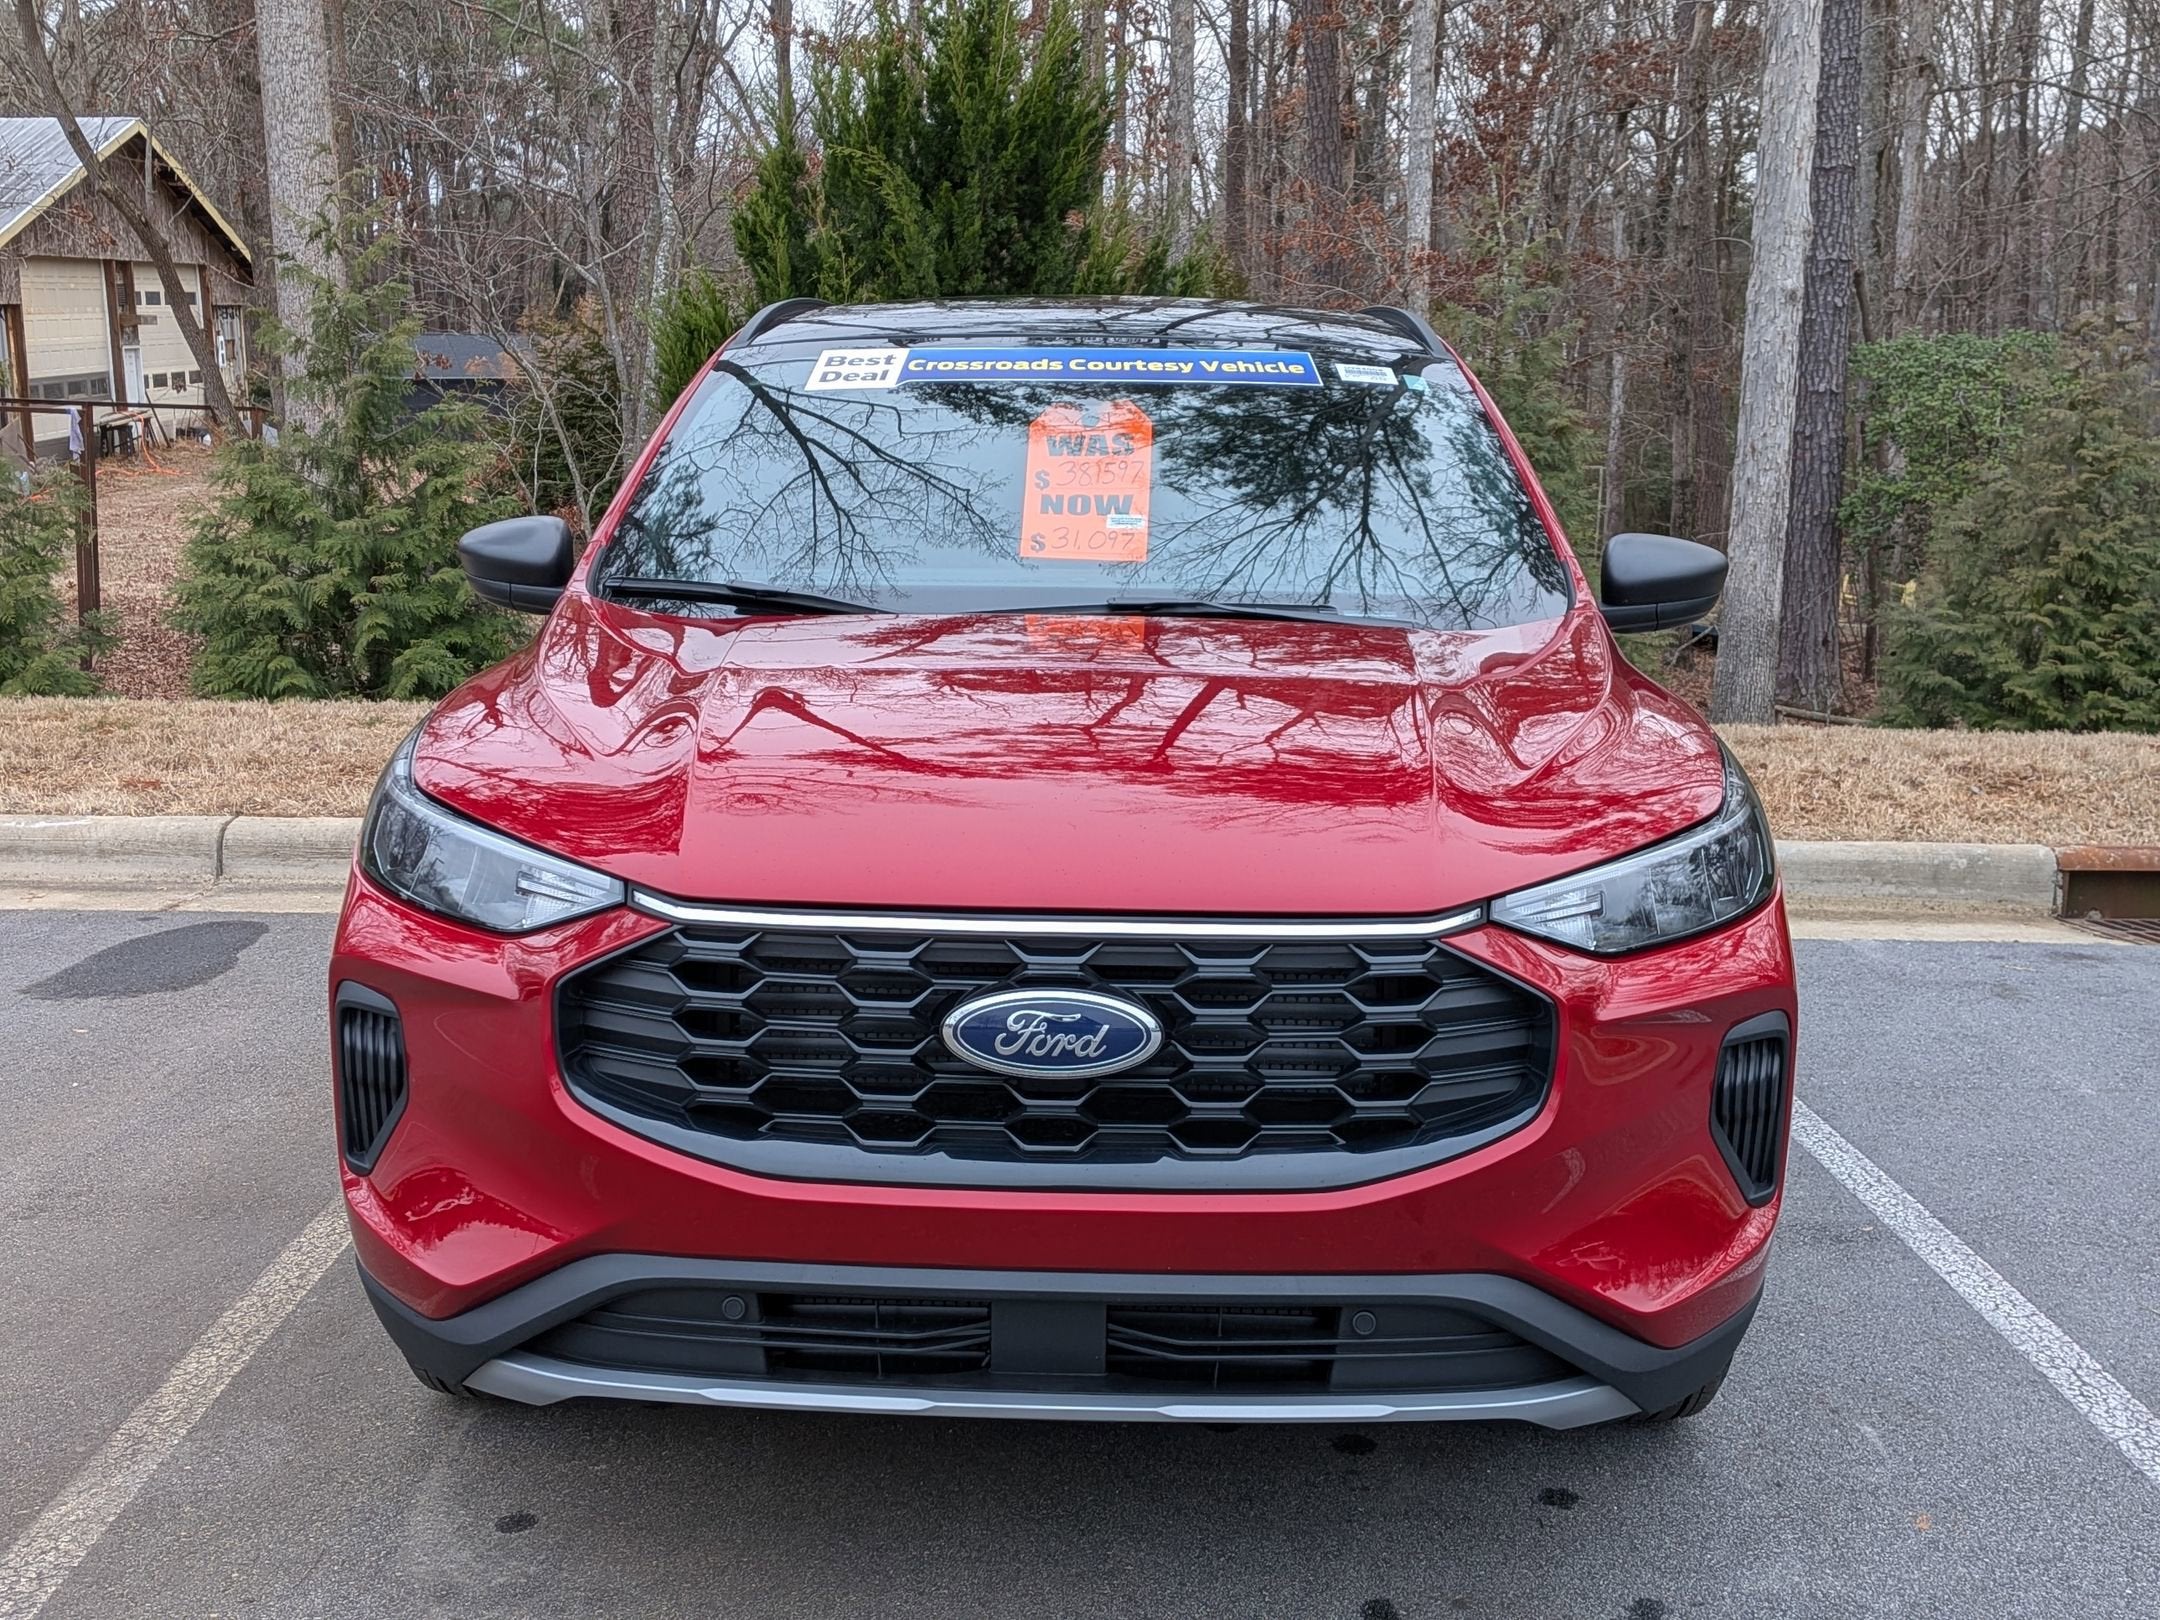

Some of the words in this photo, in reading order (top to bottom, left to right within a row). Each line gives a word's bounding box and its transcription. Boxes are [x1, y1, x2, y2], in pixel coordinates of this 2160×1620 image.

[824, 353, 897, 367] Best
[908, 358, 1063, 372] Crossroads
[1069, 358, 1194, 373] Courtesy
[1199, 360, 1305, 375] Vehicle
[818, 369, 889, 383] Deal
[1046, 433, 1135, 457] WAS
[1034, 469, 1050, 491] $
[1040, 494, 1134, 516] NOW
[1030, 532, 1046, 553] $
[994, 1009, 1110, 1058] Ford
